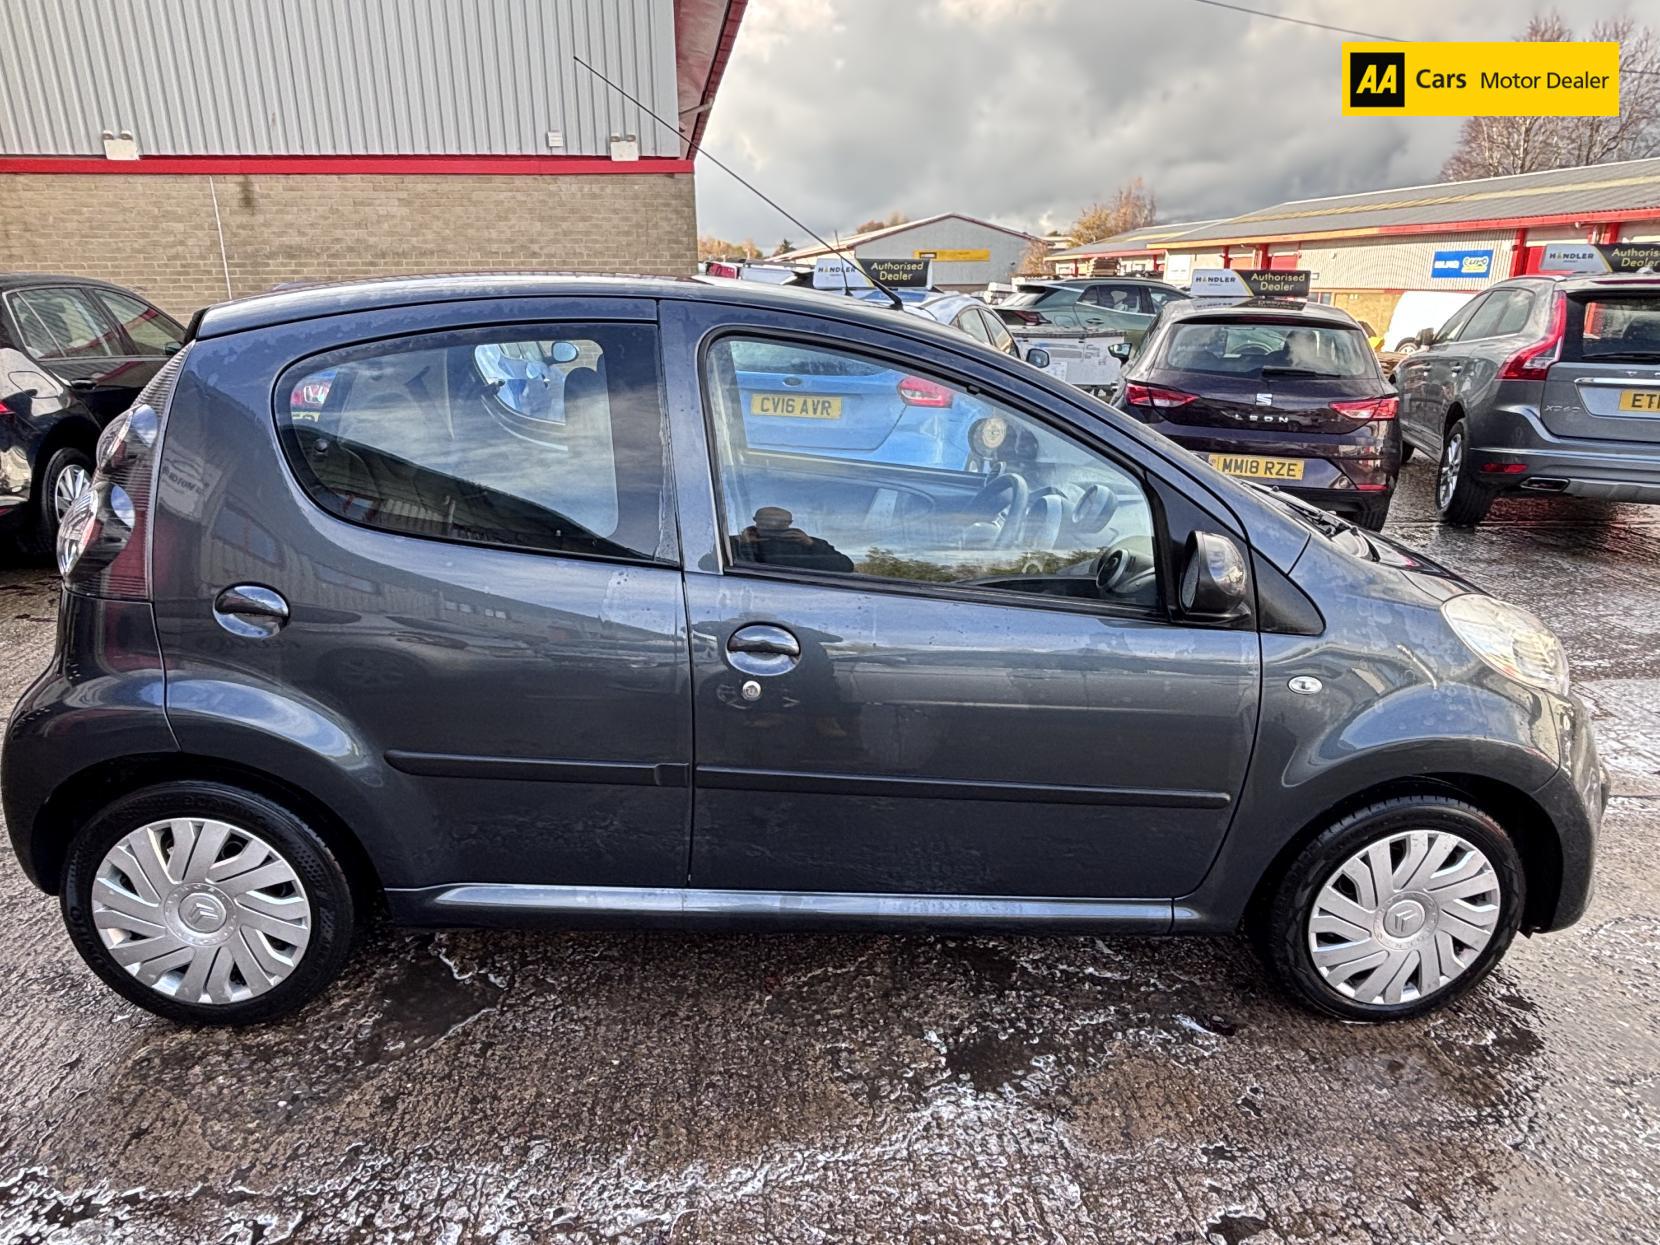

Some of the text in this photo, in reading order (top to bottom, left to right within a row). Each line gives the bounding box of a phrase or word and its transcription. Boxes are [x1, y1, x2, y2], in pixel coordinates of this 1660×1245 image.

[1612, 247, 1660, 257] Authoris
[871, 261, 925, 271] Authorised
[1621, 257, 1659, 267] Dealer
[880, 271, 913, 281] Dealer
[1251, 273, 1306, 282] Authorised
[1260, 281, 1295, 291] Dealer
[760, 397, 832, 416] CV16 AVR
[1221, 458, 1298, 478] MM18 RZE
